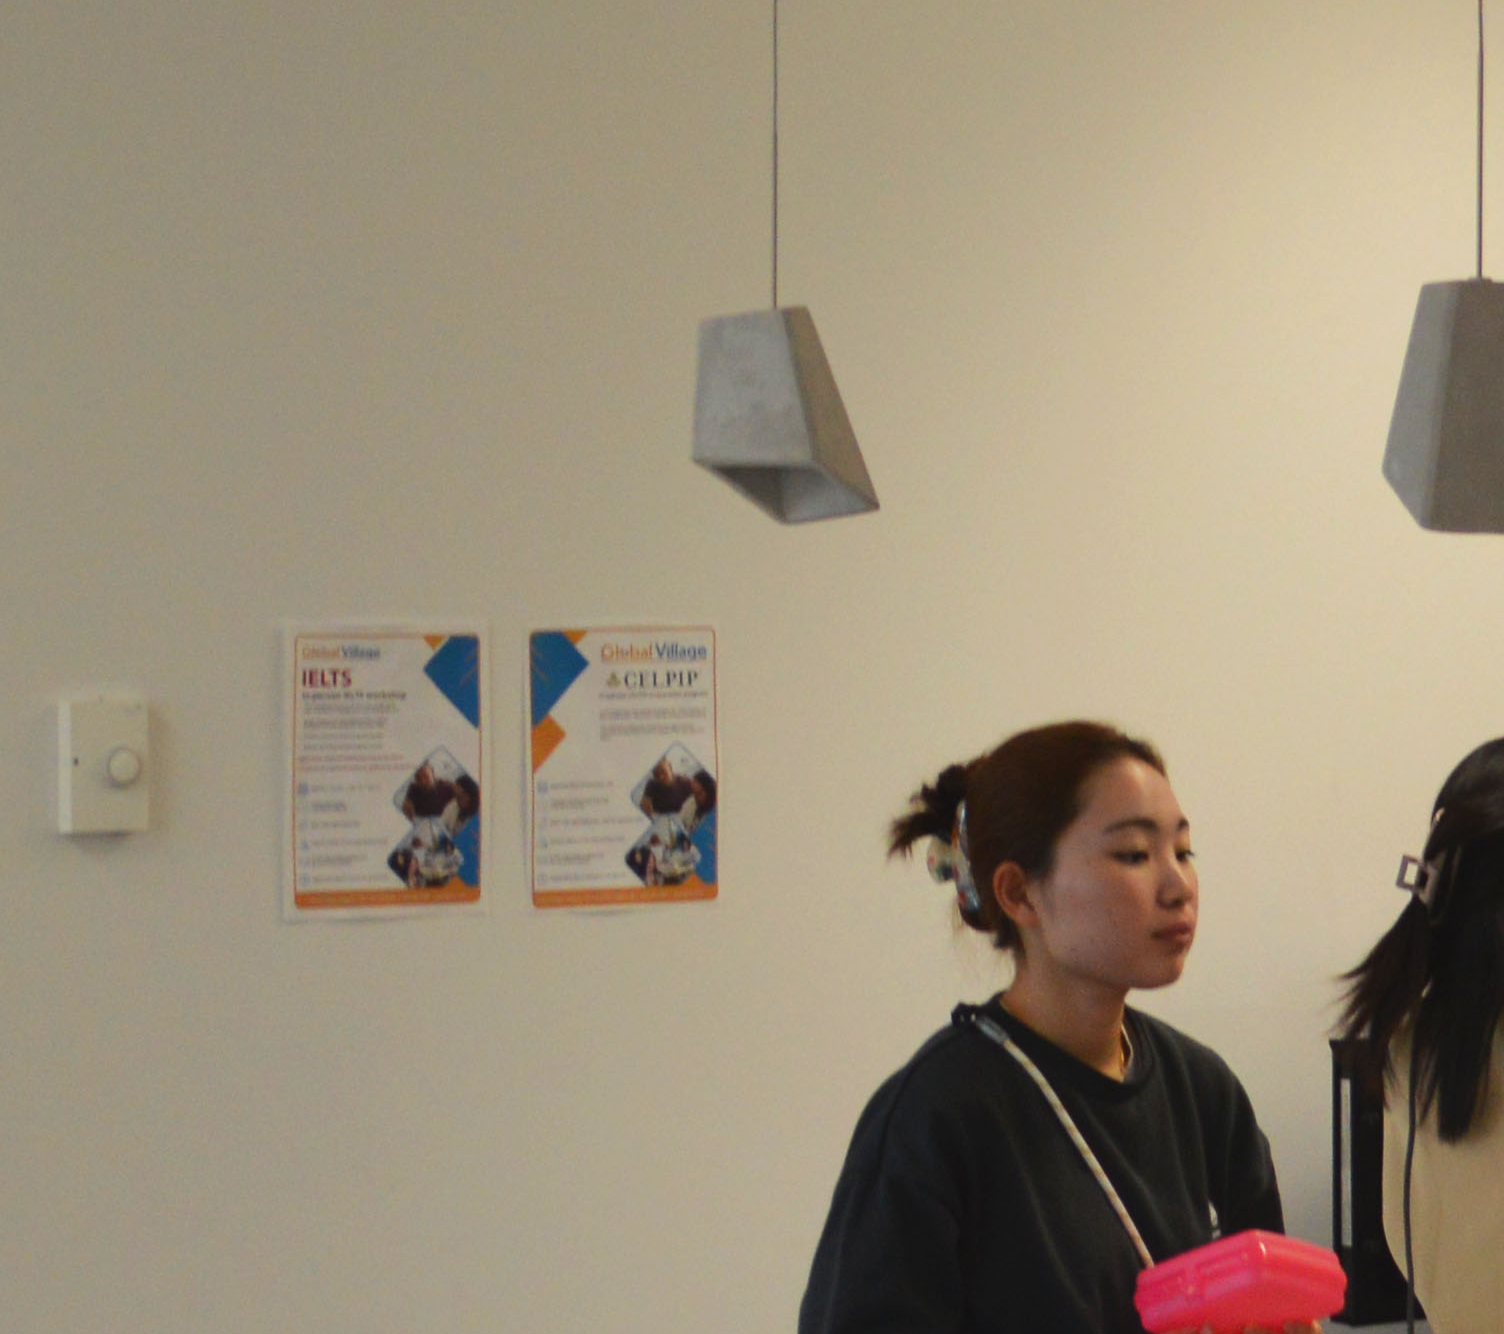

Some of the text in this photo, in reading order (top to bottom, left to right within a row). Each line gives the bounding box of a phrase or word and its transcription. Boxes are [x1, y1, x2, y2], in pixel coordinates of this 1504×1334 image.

[342, 644, 381, 662] Village
[601, 643, 707, 662] Global Village
[302, 669, 352, 687] IELTS
[624, 671, 699, 688] CELPIP
